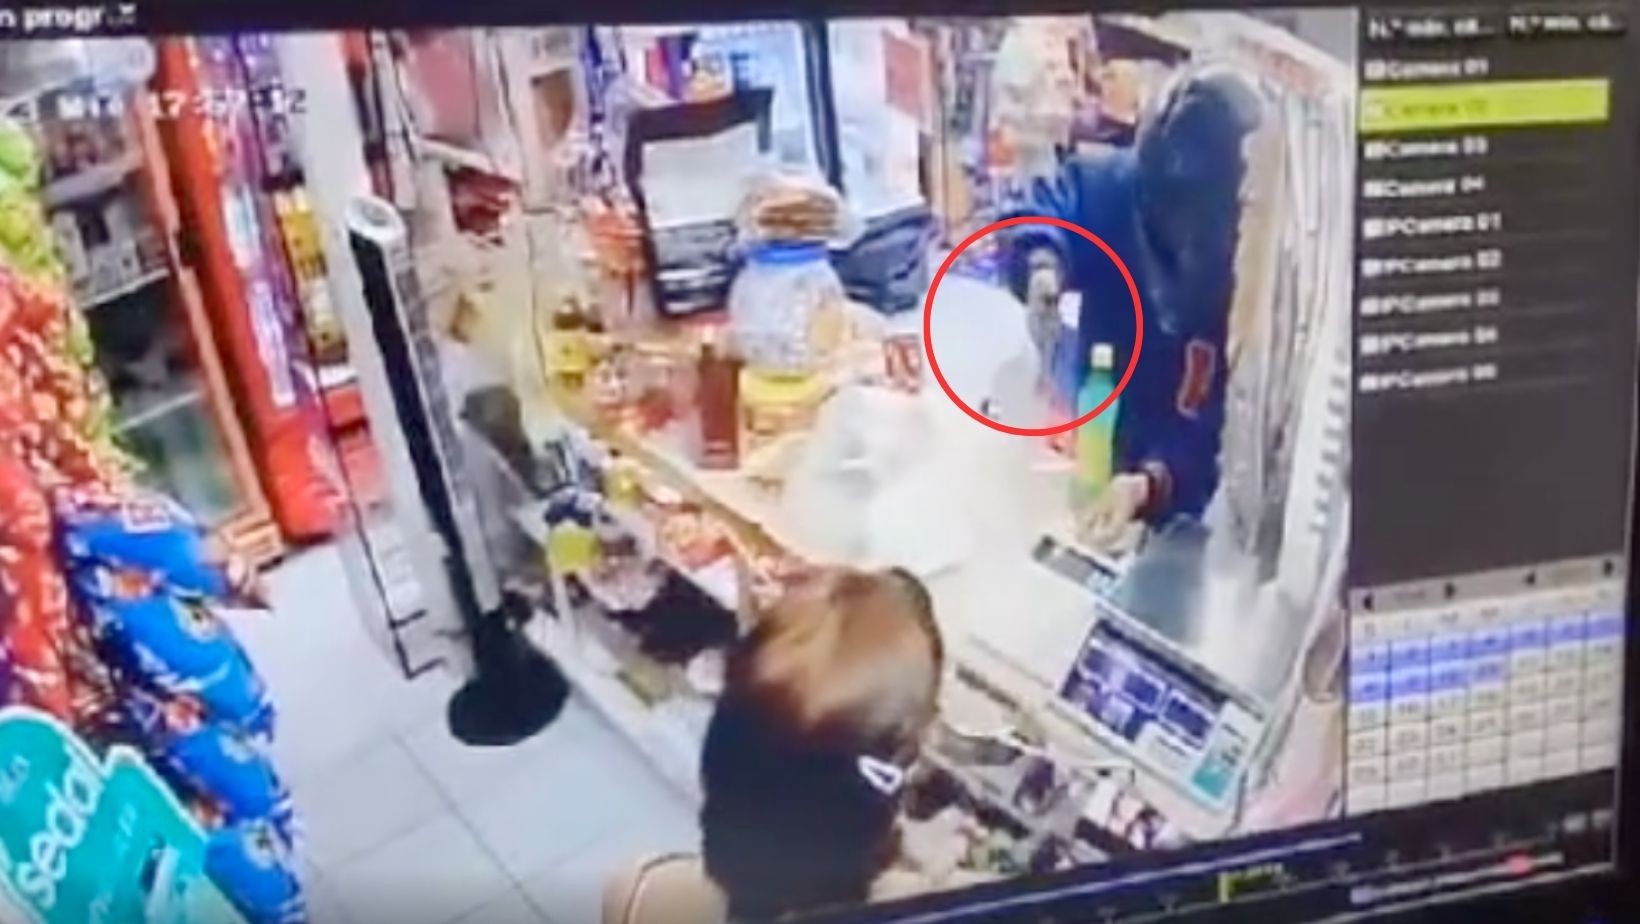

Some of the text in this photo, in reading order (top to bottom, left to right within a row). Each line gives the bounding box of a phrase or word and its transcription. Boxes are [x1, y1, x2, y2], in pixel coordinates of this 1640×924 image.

[1386, 57, 1488, 79] Camera 01
[1385, 140, 1459, 157] Camera
[1385, 178, 1457, 197] Camera
